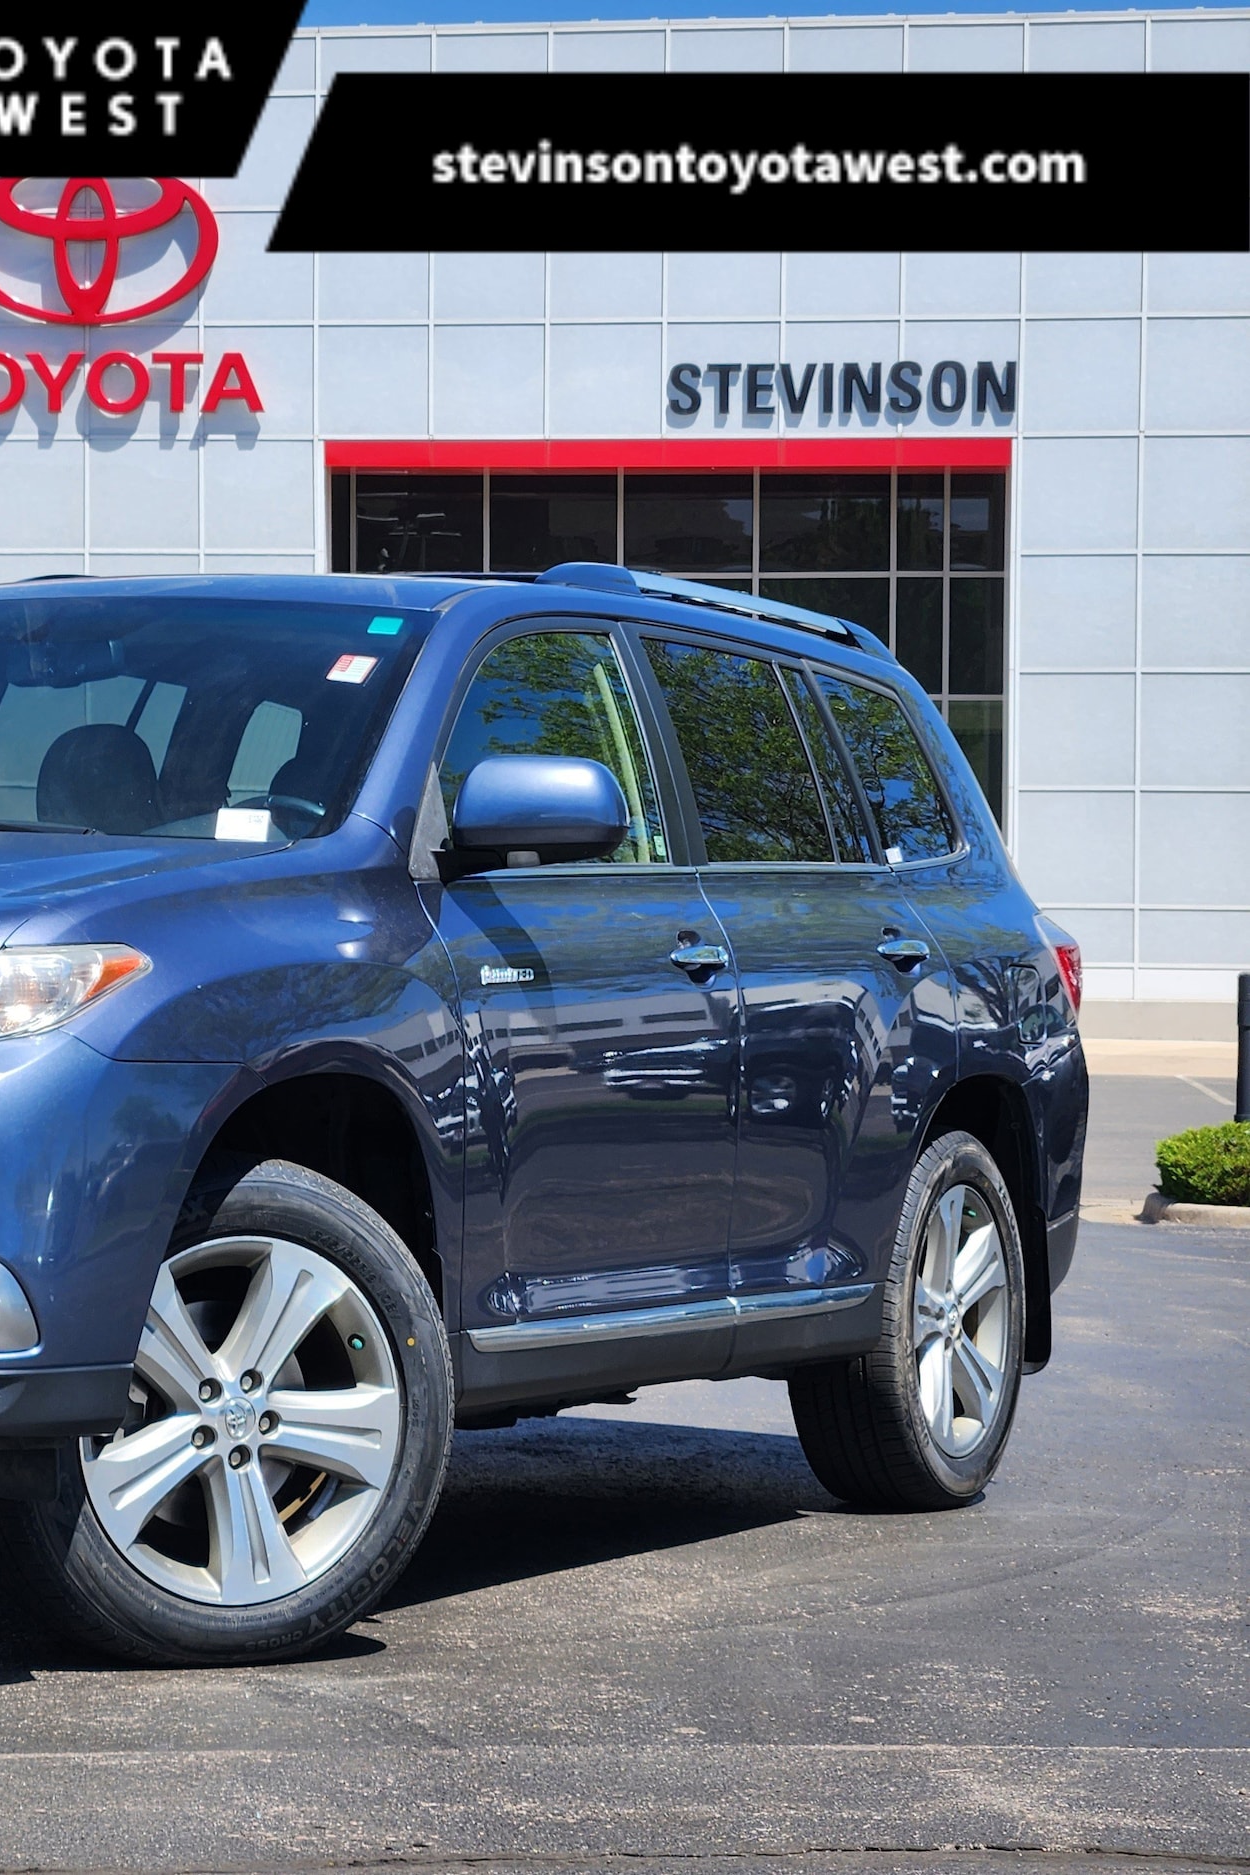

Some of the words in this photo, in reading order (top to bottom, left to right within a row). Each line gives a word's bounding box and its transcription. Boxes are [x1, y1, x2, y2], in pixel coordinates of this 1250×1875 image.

[668, 359, 1017, 416] STEVINSON
[307, 1500, 424, 1635] VELOCITY
[245, 1629, 305, 1651] CROSS
